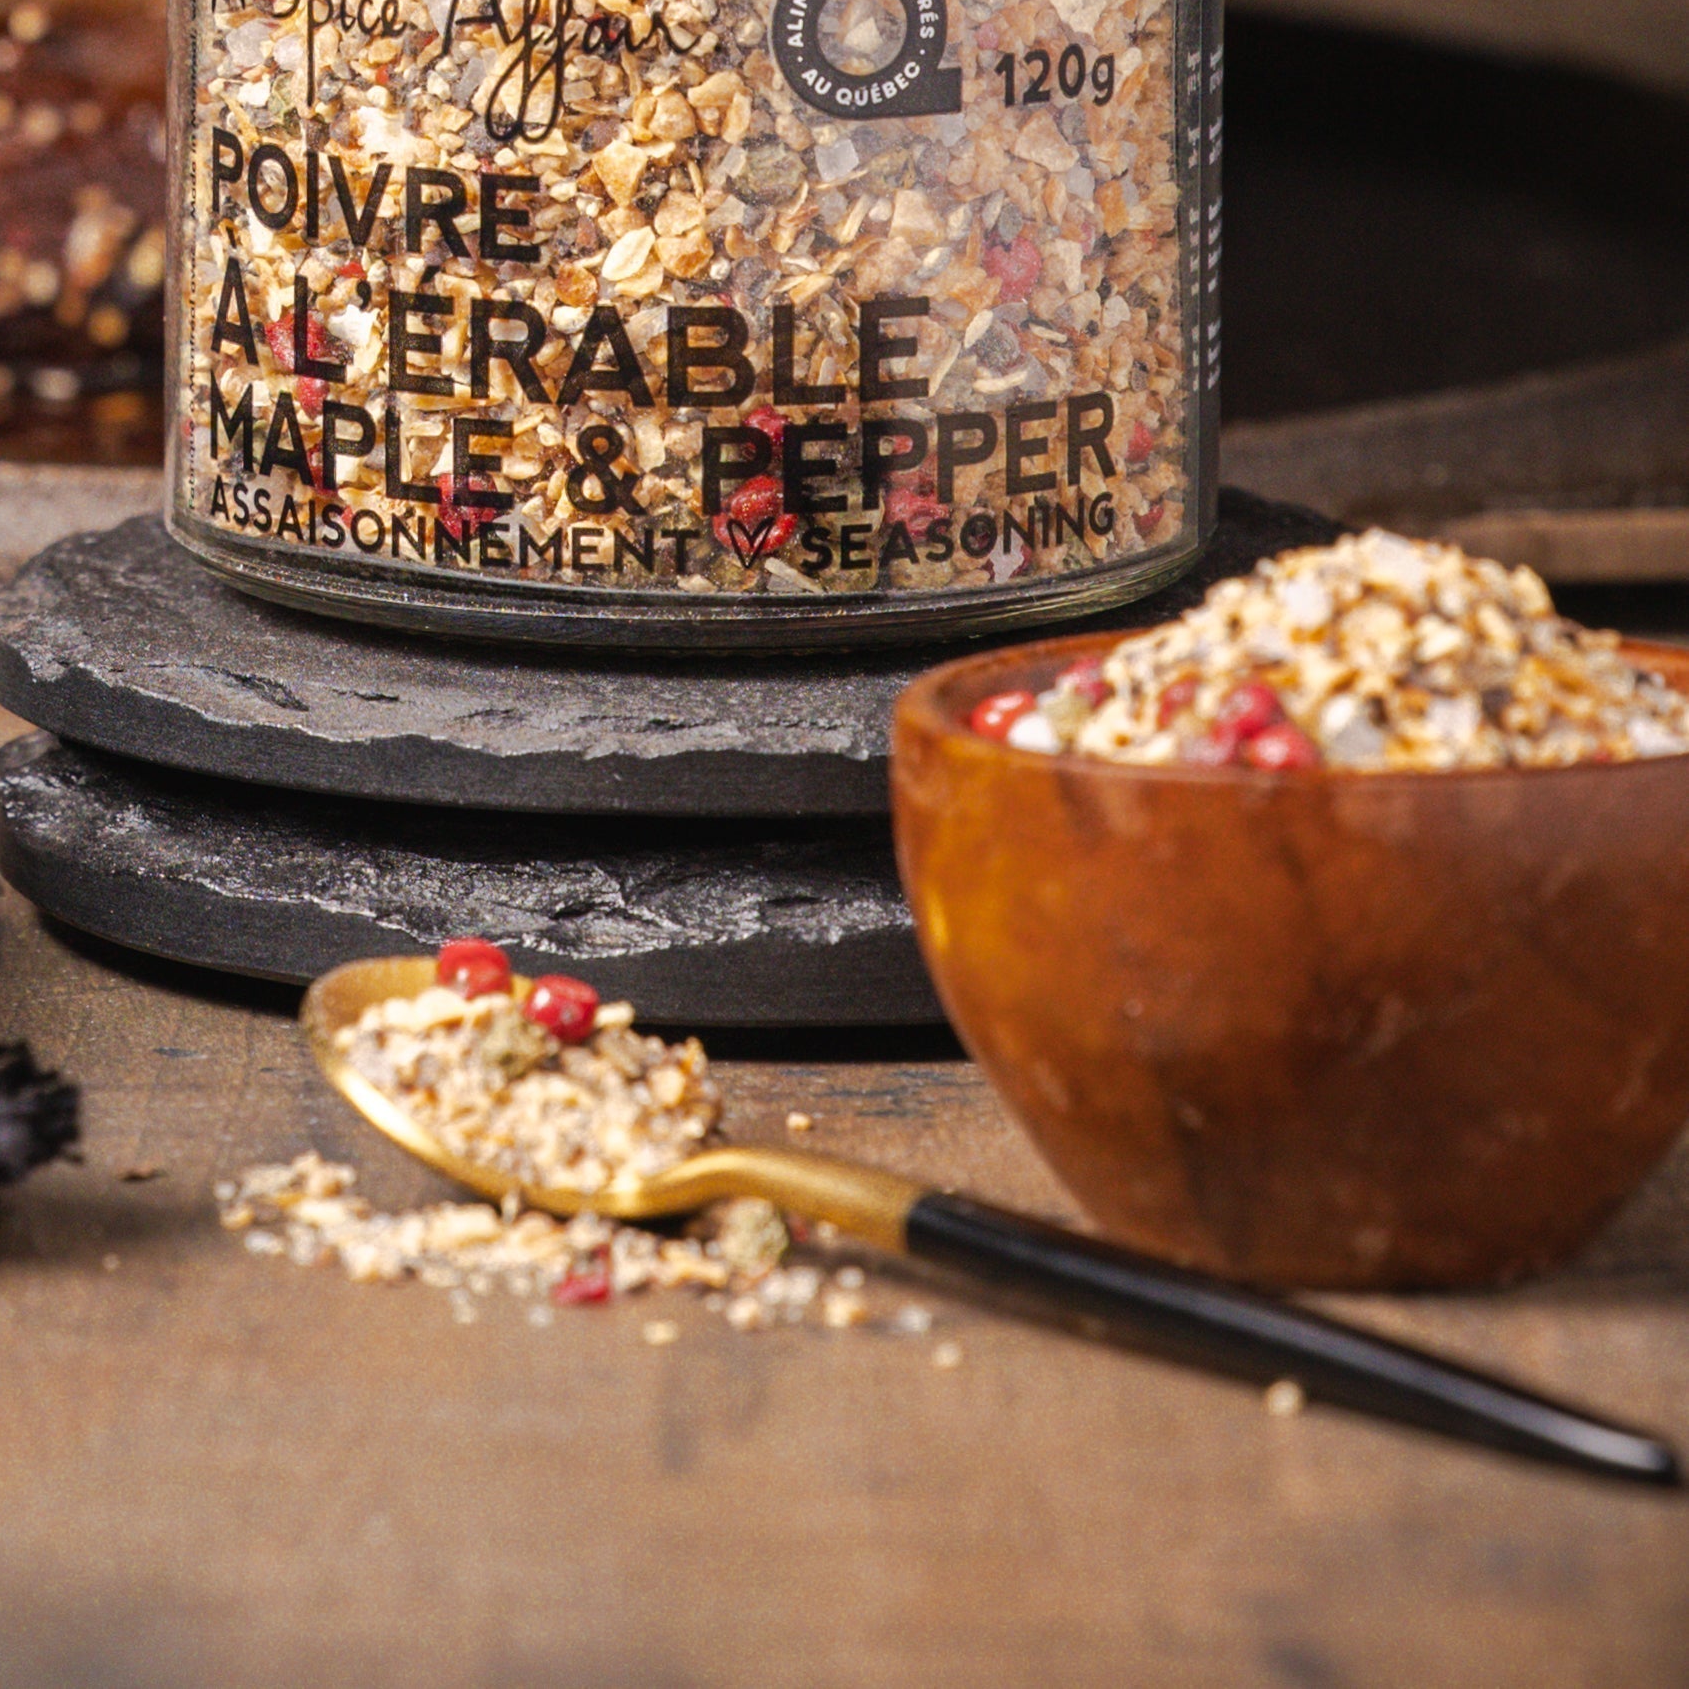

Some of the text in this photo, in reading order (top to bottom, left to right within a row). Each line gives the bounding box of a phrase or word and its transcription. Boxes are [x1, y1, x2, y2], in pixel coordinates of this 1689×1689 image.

[801, 61, 921, 107] AU QUÉBEC
[995, 42, 1115, 109] 120g
[212, 126, 540, 262] POIVRE
[210, 370, 1117, 517] MAPLE & PEPPER
[210, 474, 1114, 575] ASSAISONNEMENT SEASONING
